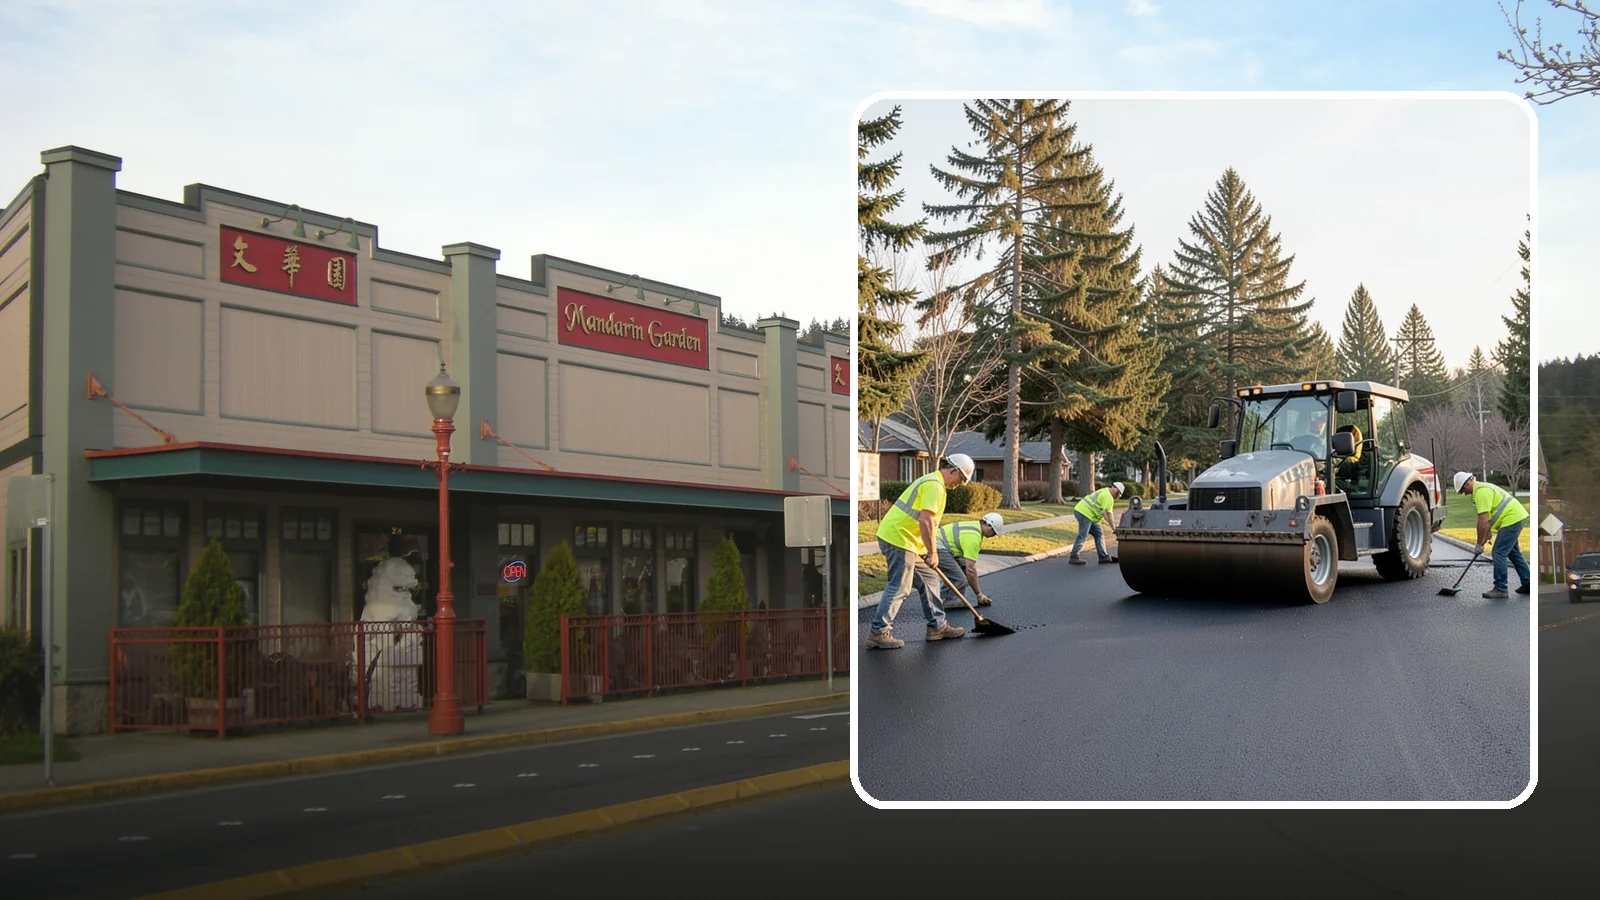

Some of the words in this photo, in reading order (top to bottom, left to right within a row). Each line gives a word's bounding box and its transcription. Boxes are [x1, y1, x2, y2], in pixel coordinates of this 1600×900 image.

[231, 236, 346, 291] 文華園
[565, 302, 644, 341] Mandarin
[648, 320, 701, 352] Garden
[503, 565, 526, 578] OPEN
